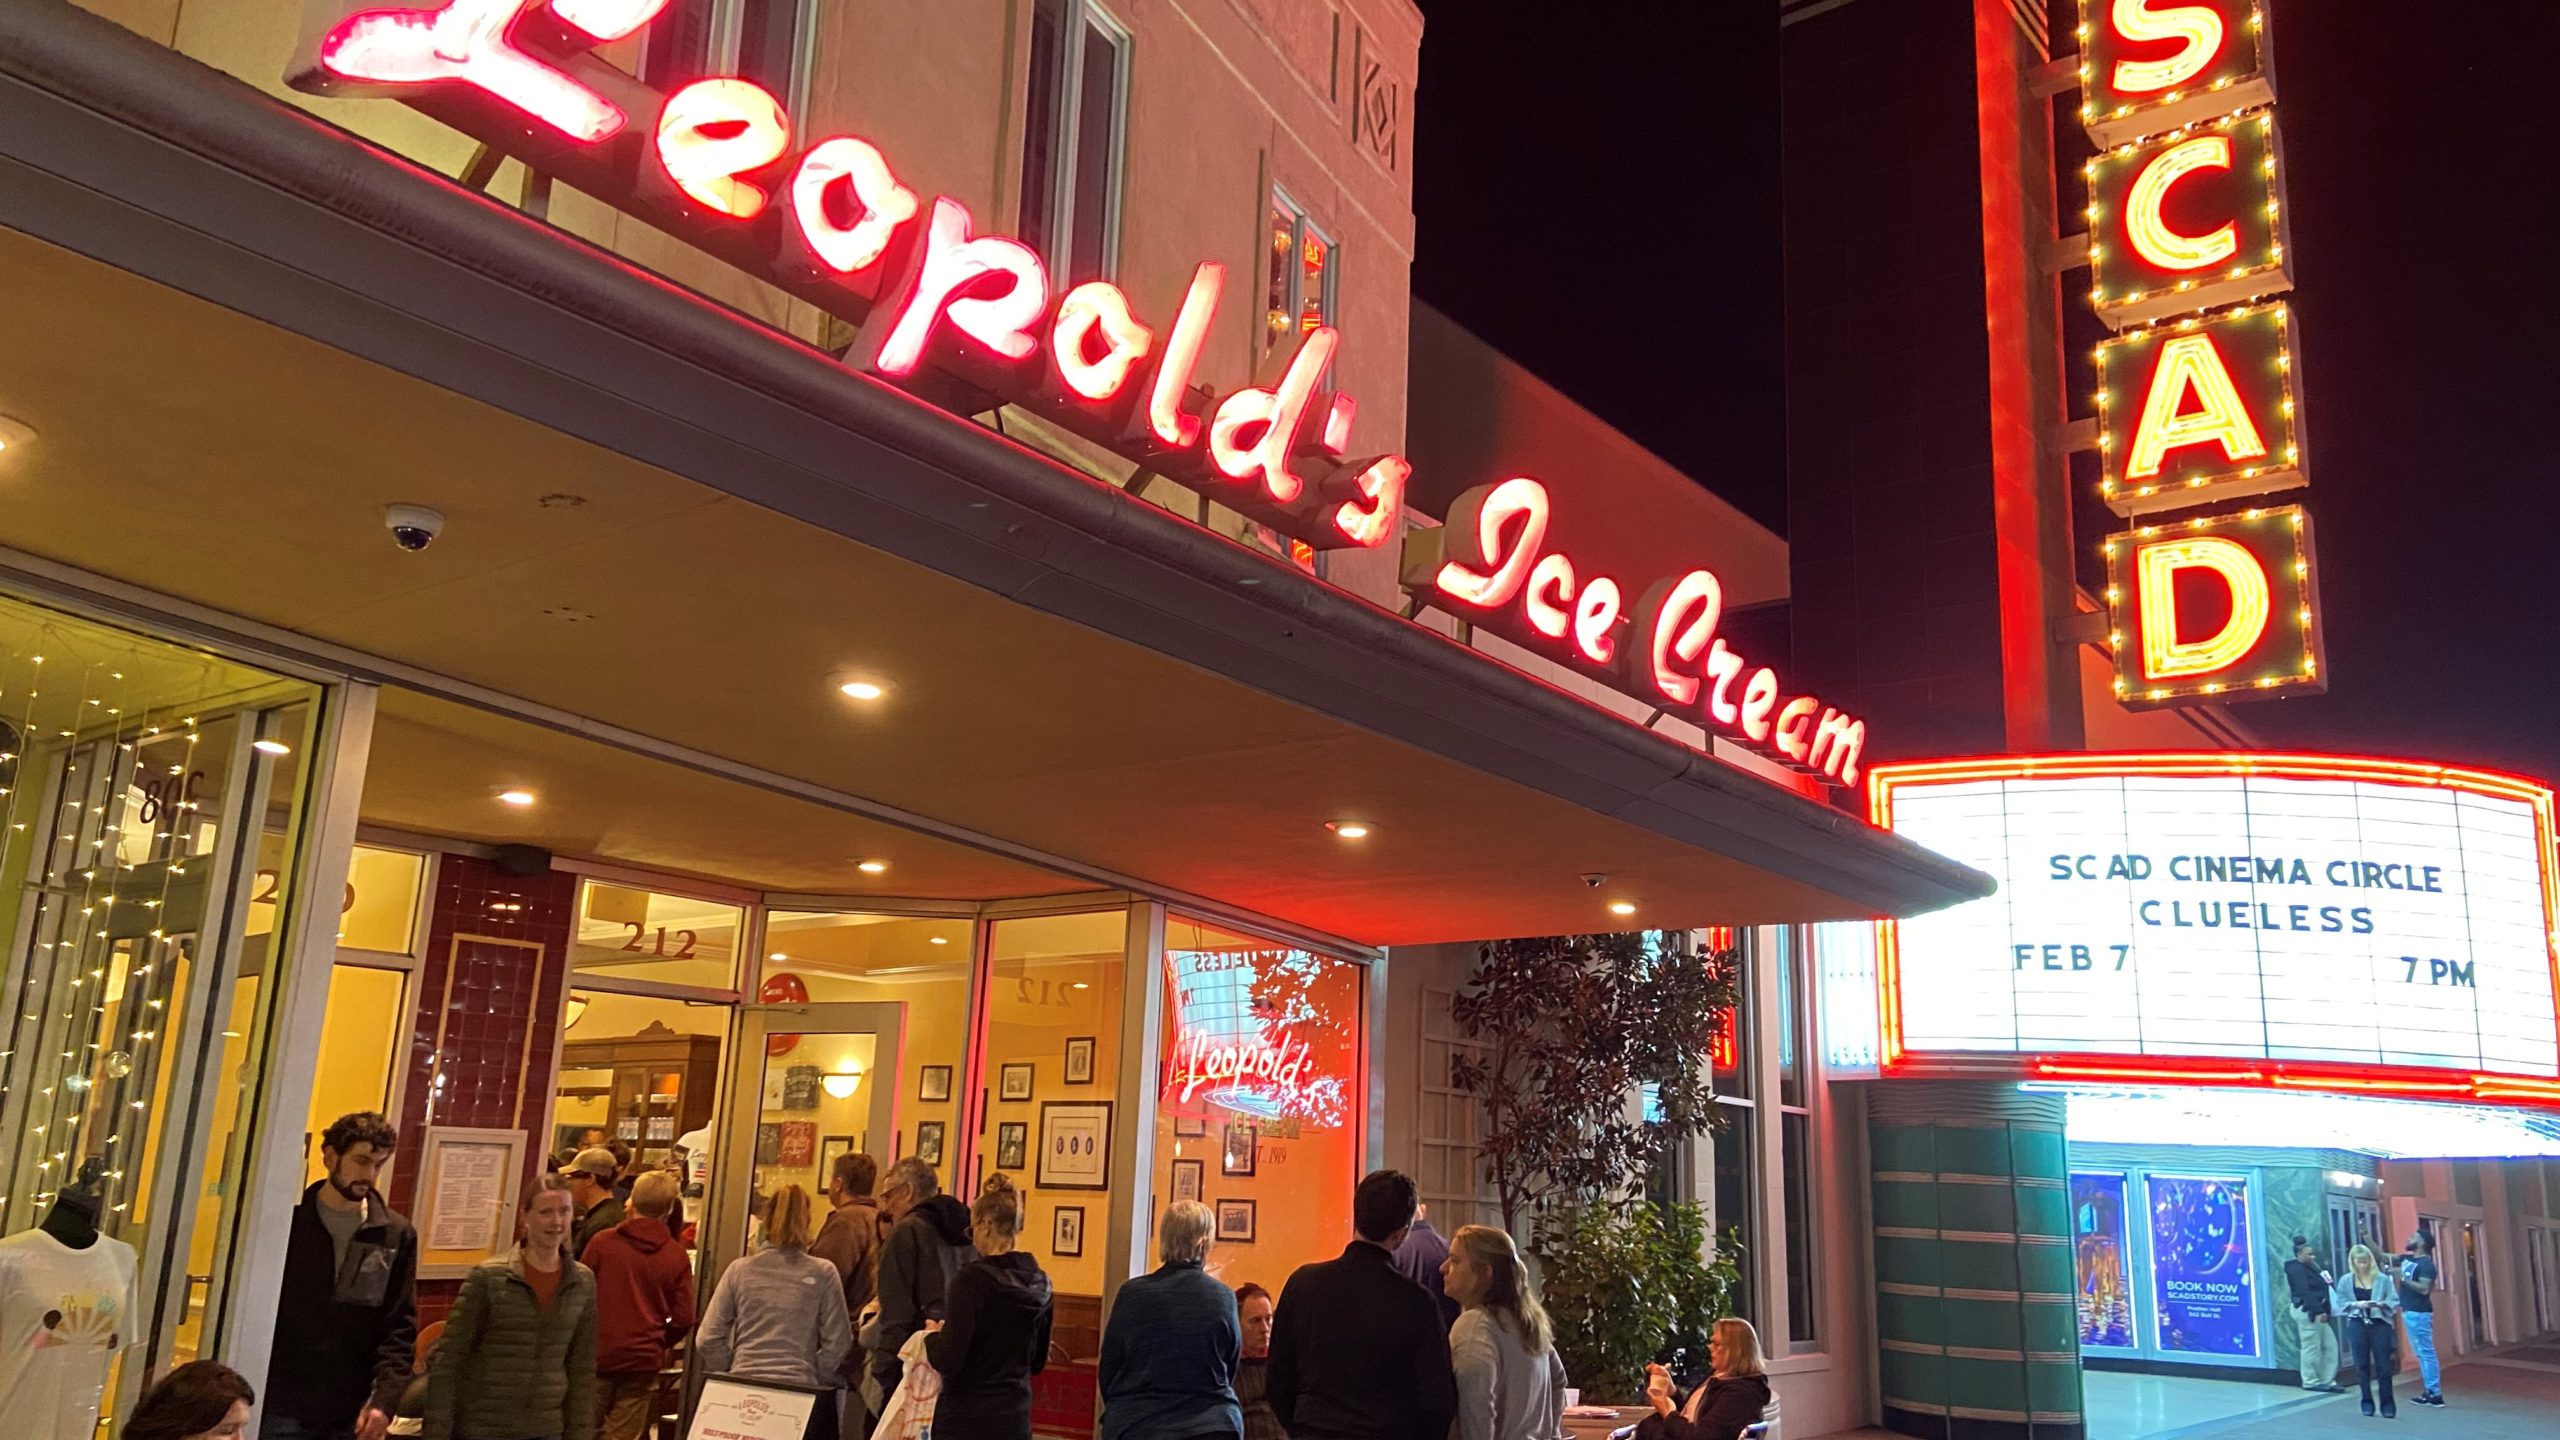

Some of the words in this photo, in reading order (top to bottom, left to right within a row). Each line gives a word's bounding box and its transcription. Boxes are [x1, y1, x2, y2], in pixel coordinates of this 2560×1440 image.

[2111, 0, 2270, 683] SCAD
[1435, 477, 1621, 664] Ice
[1651, 569, 1867, 788] Cream
[2049, 854, 2152, 881] SCAD
[2169, 855, 2312, 885] CINEMA
[2325, 860, 2443, 893] CIRCLE
[2139, 899, 2374, 934] CLUELESS
[621, 920, 698, 961] 212
[2014, 944, 2093, 971] FEB
[2108, 944, 2130, 971] 7
[2400, 956, 2418, 983] 7
[2429, 958, 2476, 988] PM
[1268, 1145, 1288, 1165] 1919
[2166, 1280, 2203, 1292] BOOK
[2206, 1283, 2238, 1294] NOW
[2167, 1291, 2240, 1302] SCADSTORY.COM
